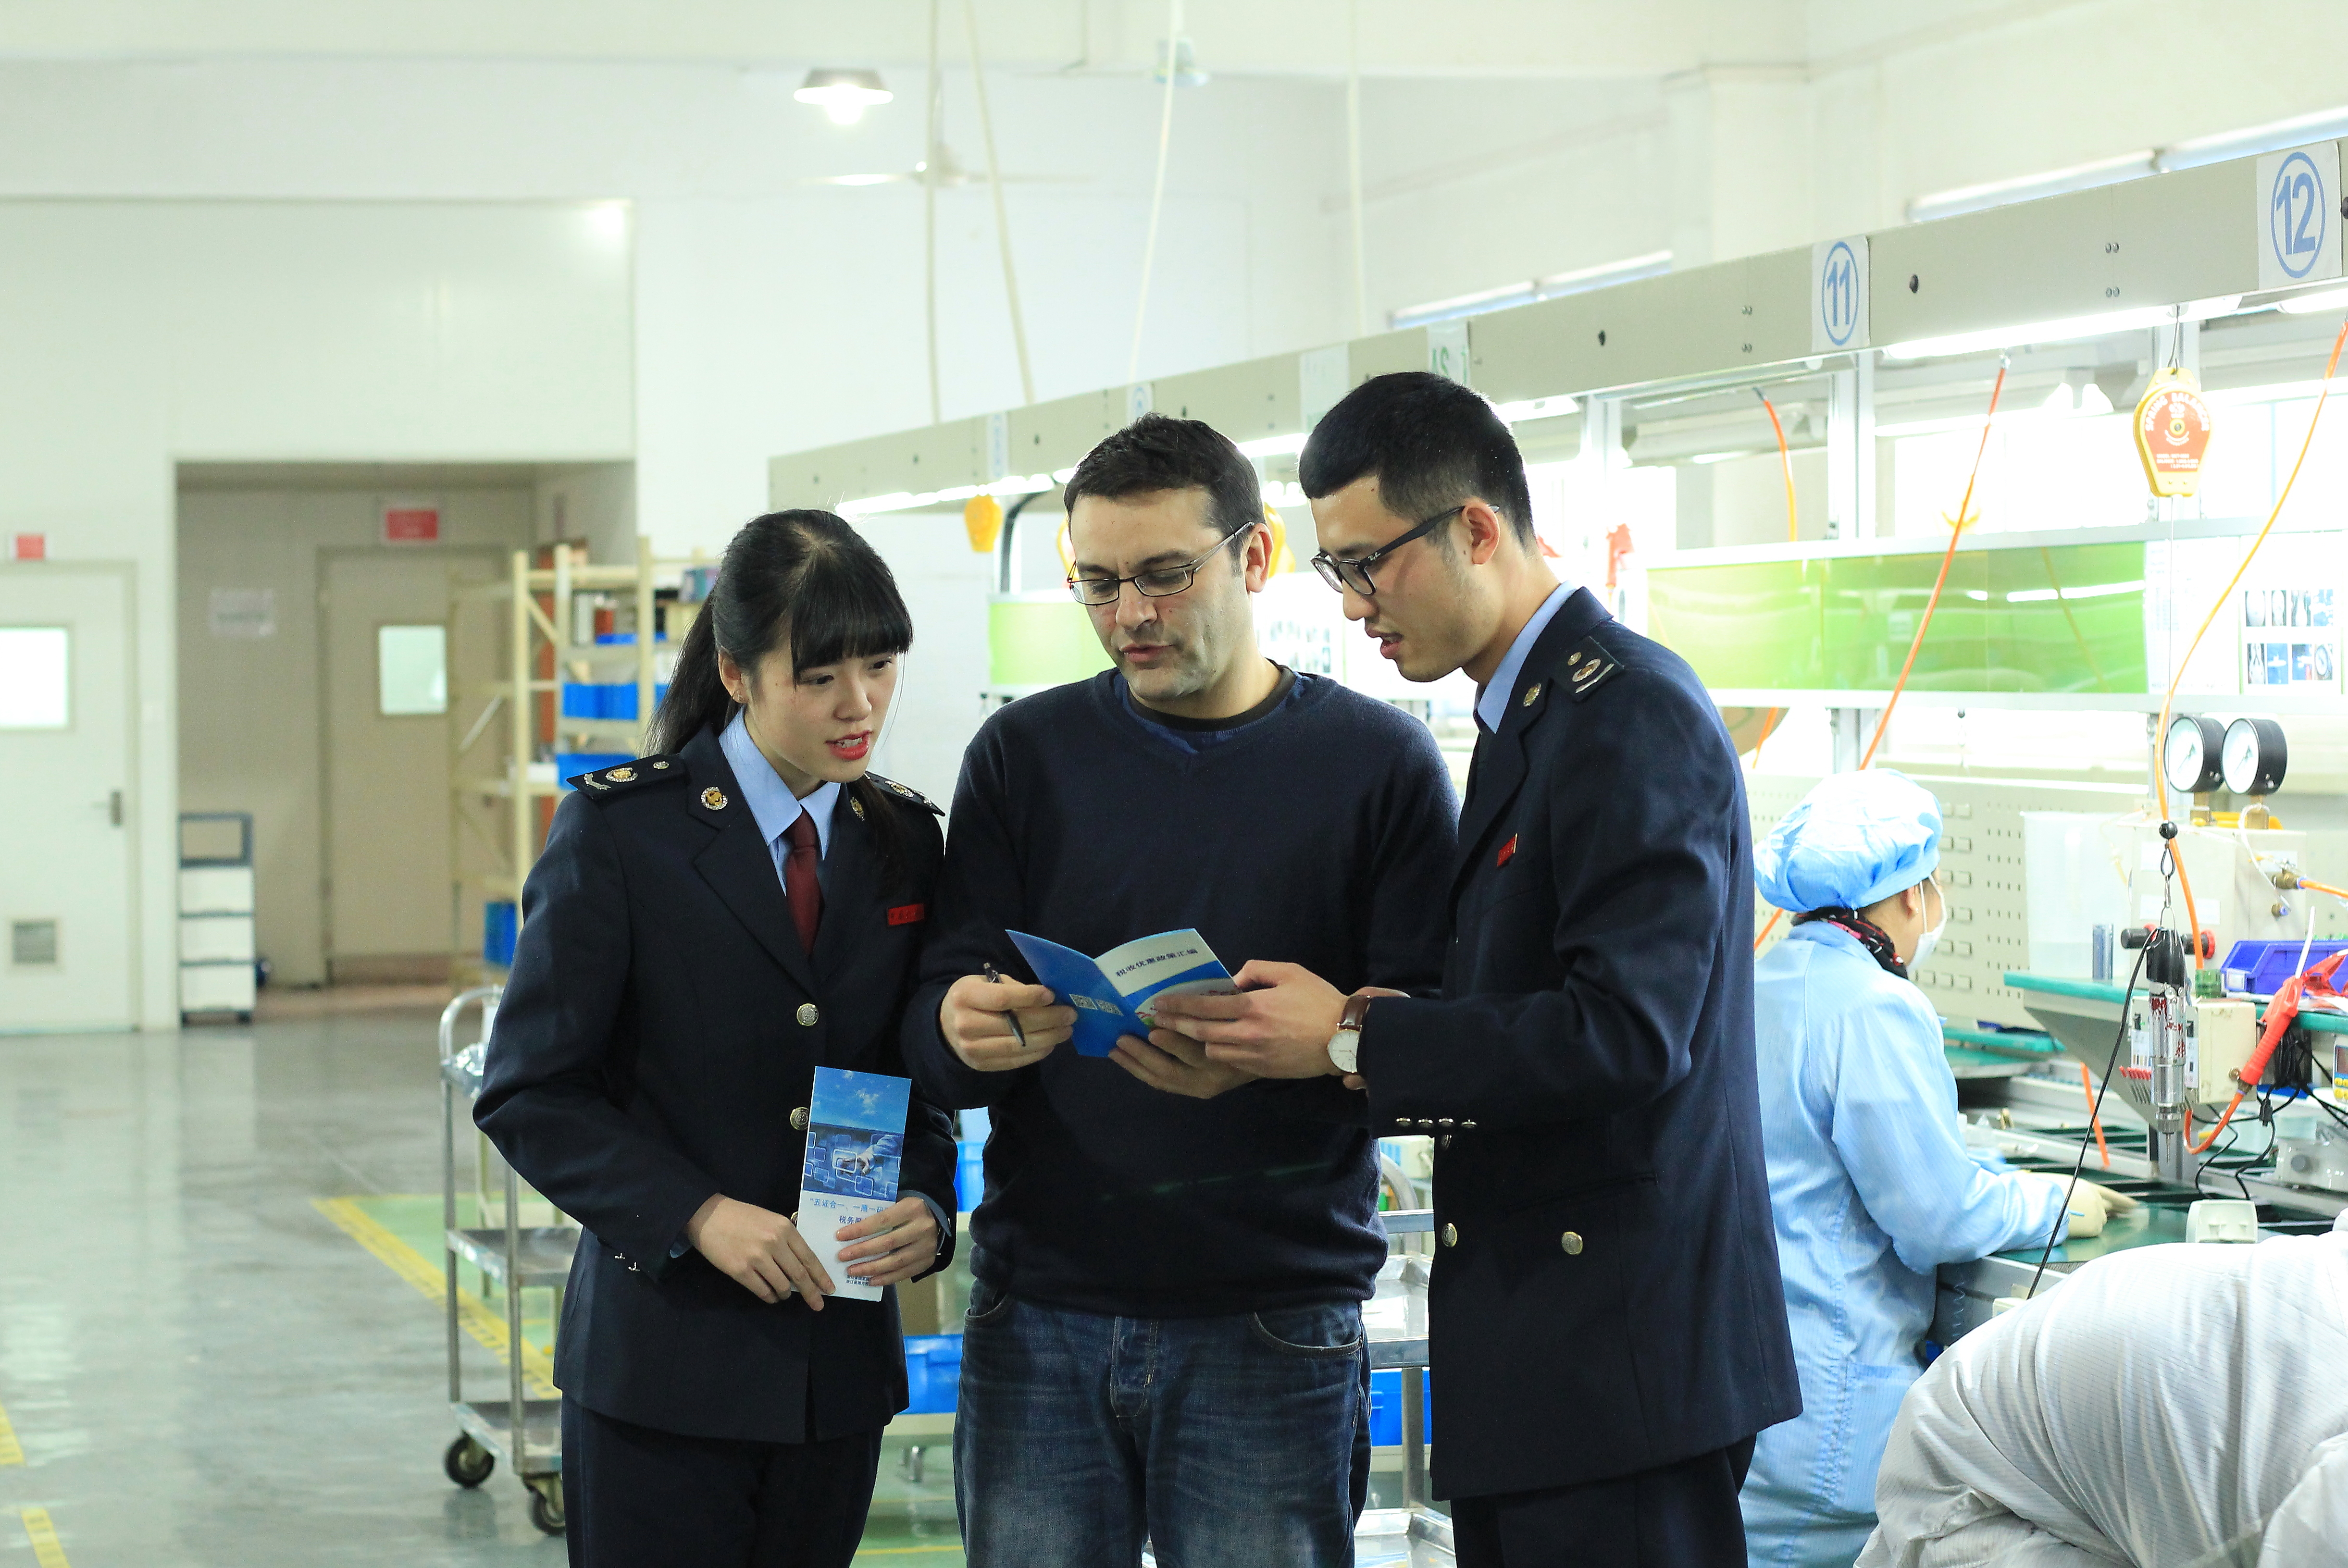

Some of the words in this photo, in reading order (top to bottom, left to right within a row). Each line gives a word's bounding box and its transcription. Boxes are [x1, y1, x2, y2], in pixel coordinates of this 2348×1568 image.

[2276, 172, 2316, 255] 12
[1827, 259, 1850, 327] 11
[2145, 395, 2168, 431] SPRING
[2172, 392, 2210, 431] BALANCER
